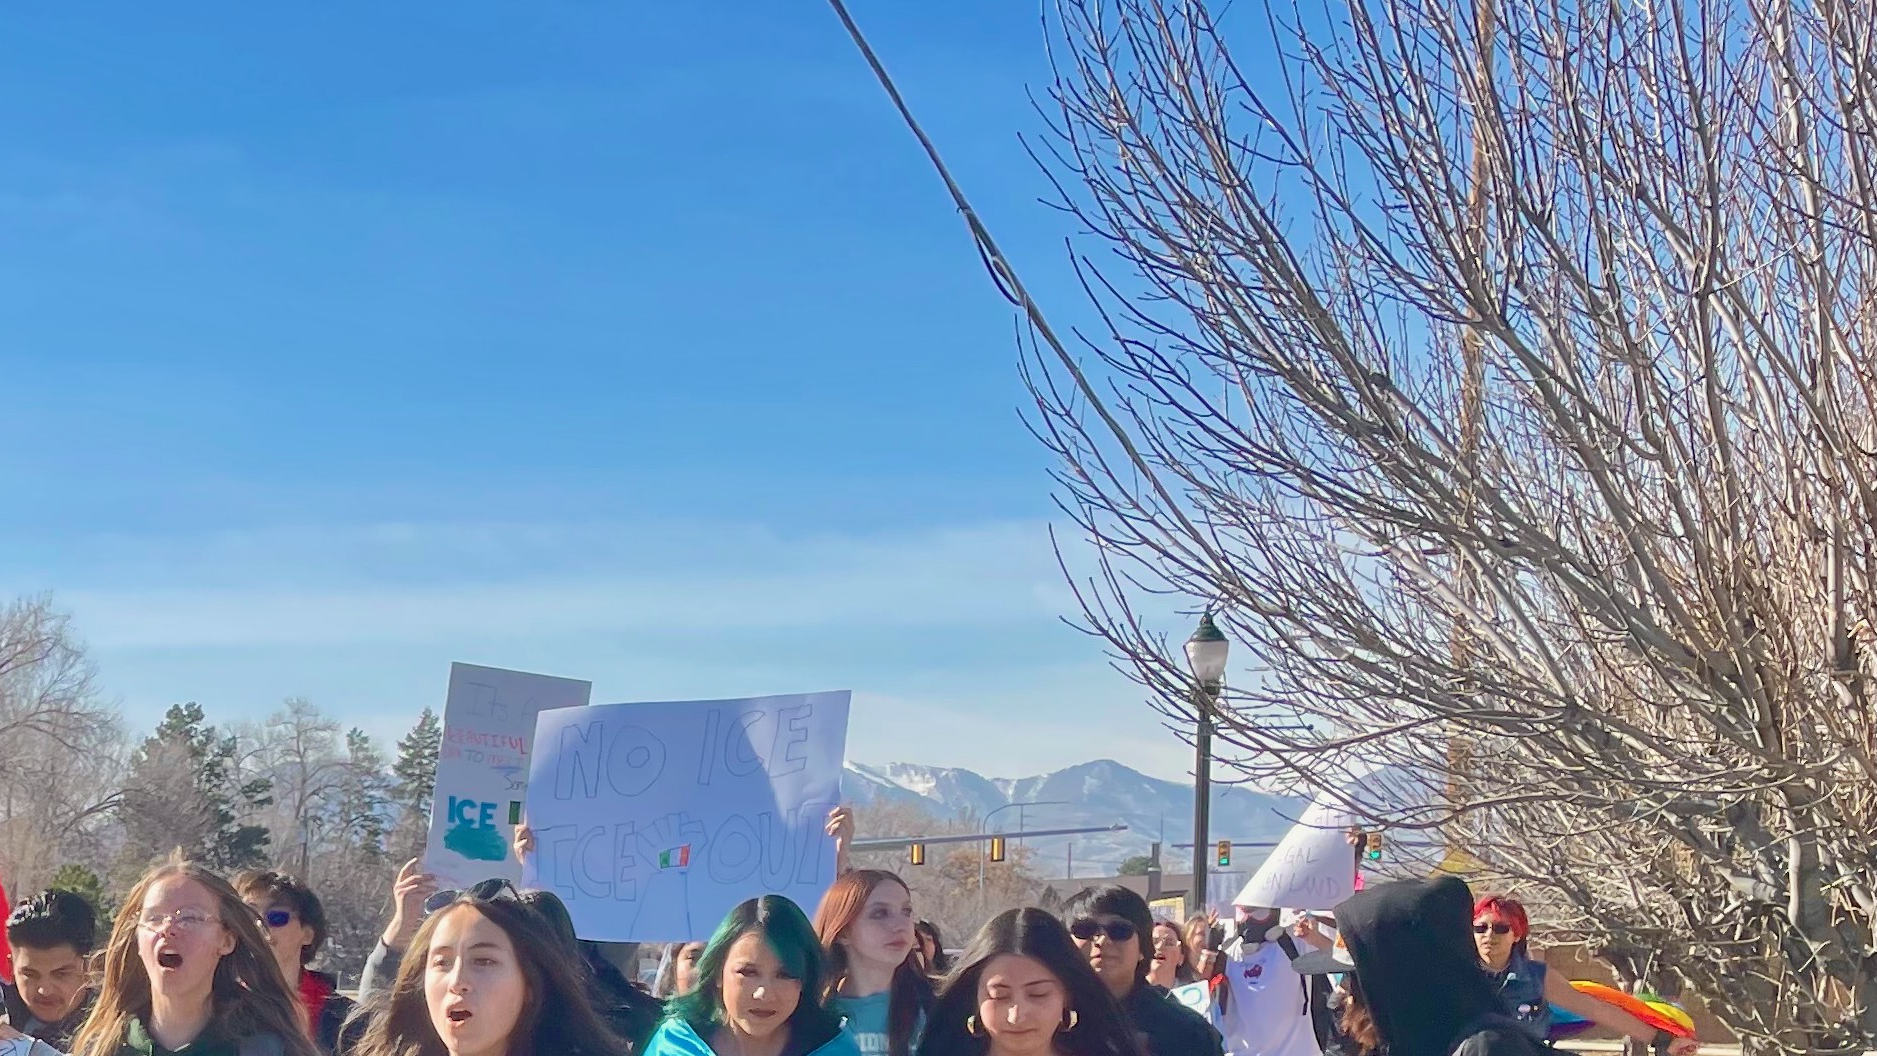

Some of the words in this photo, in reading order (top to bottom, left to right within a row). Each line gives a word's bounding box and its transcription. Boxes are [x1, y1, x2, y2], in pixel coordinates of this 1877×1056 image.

[554, 720, 667, 800] NO
[697, 704, 813, 786] ICE
[447, 795, 498, 829] ICE
[531, 821, 637, 901] ICE
[708, 801, 840, 891] OUT
